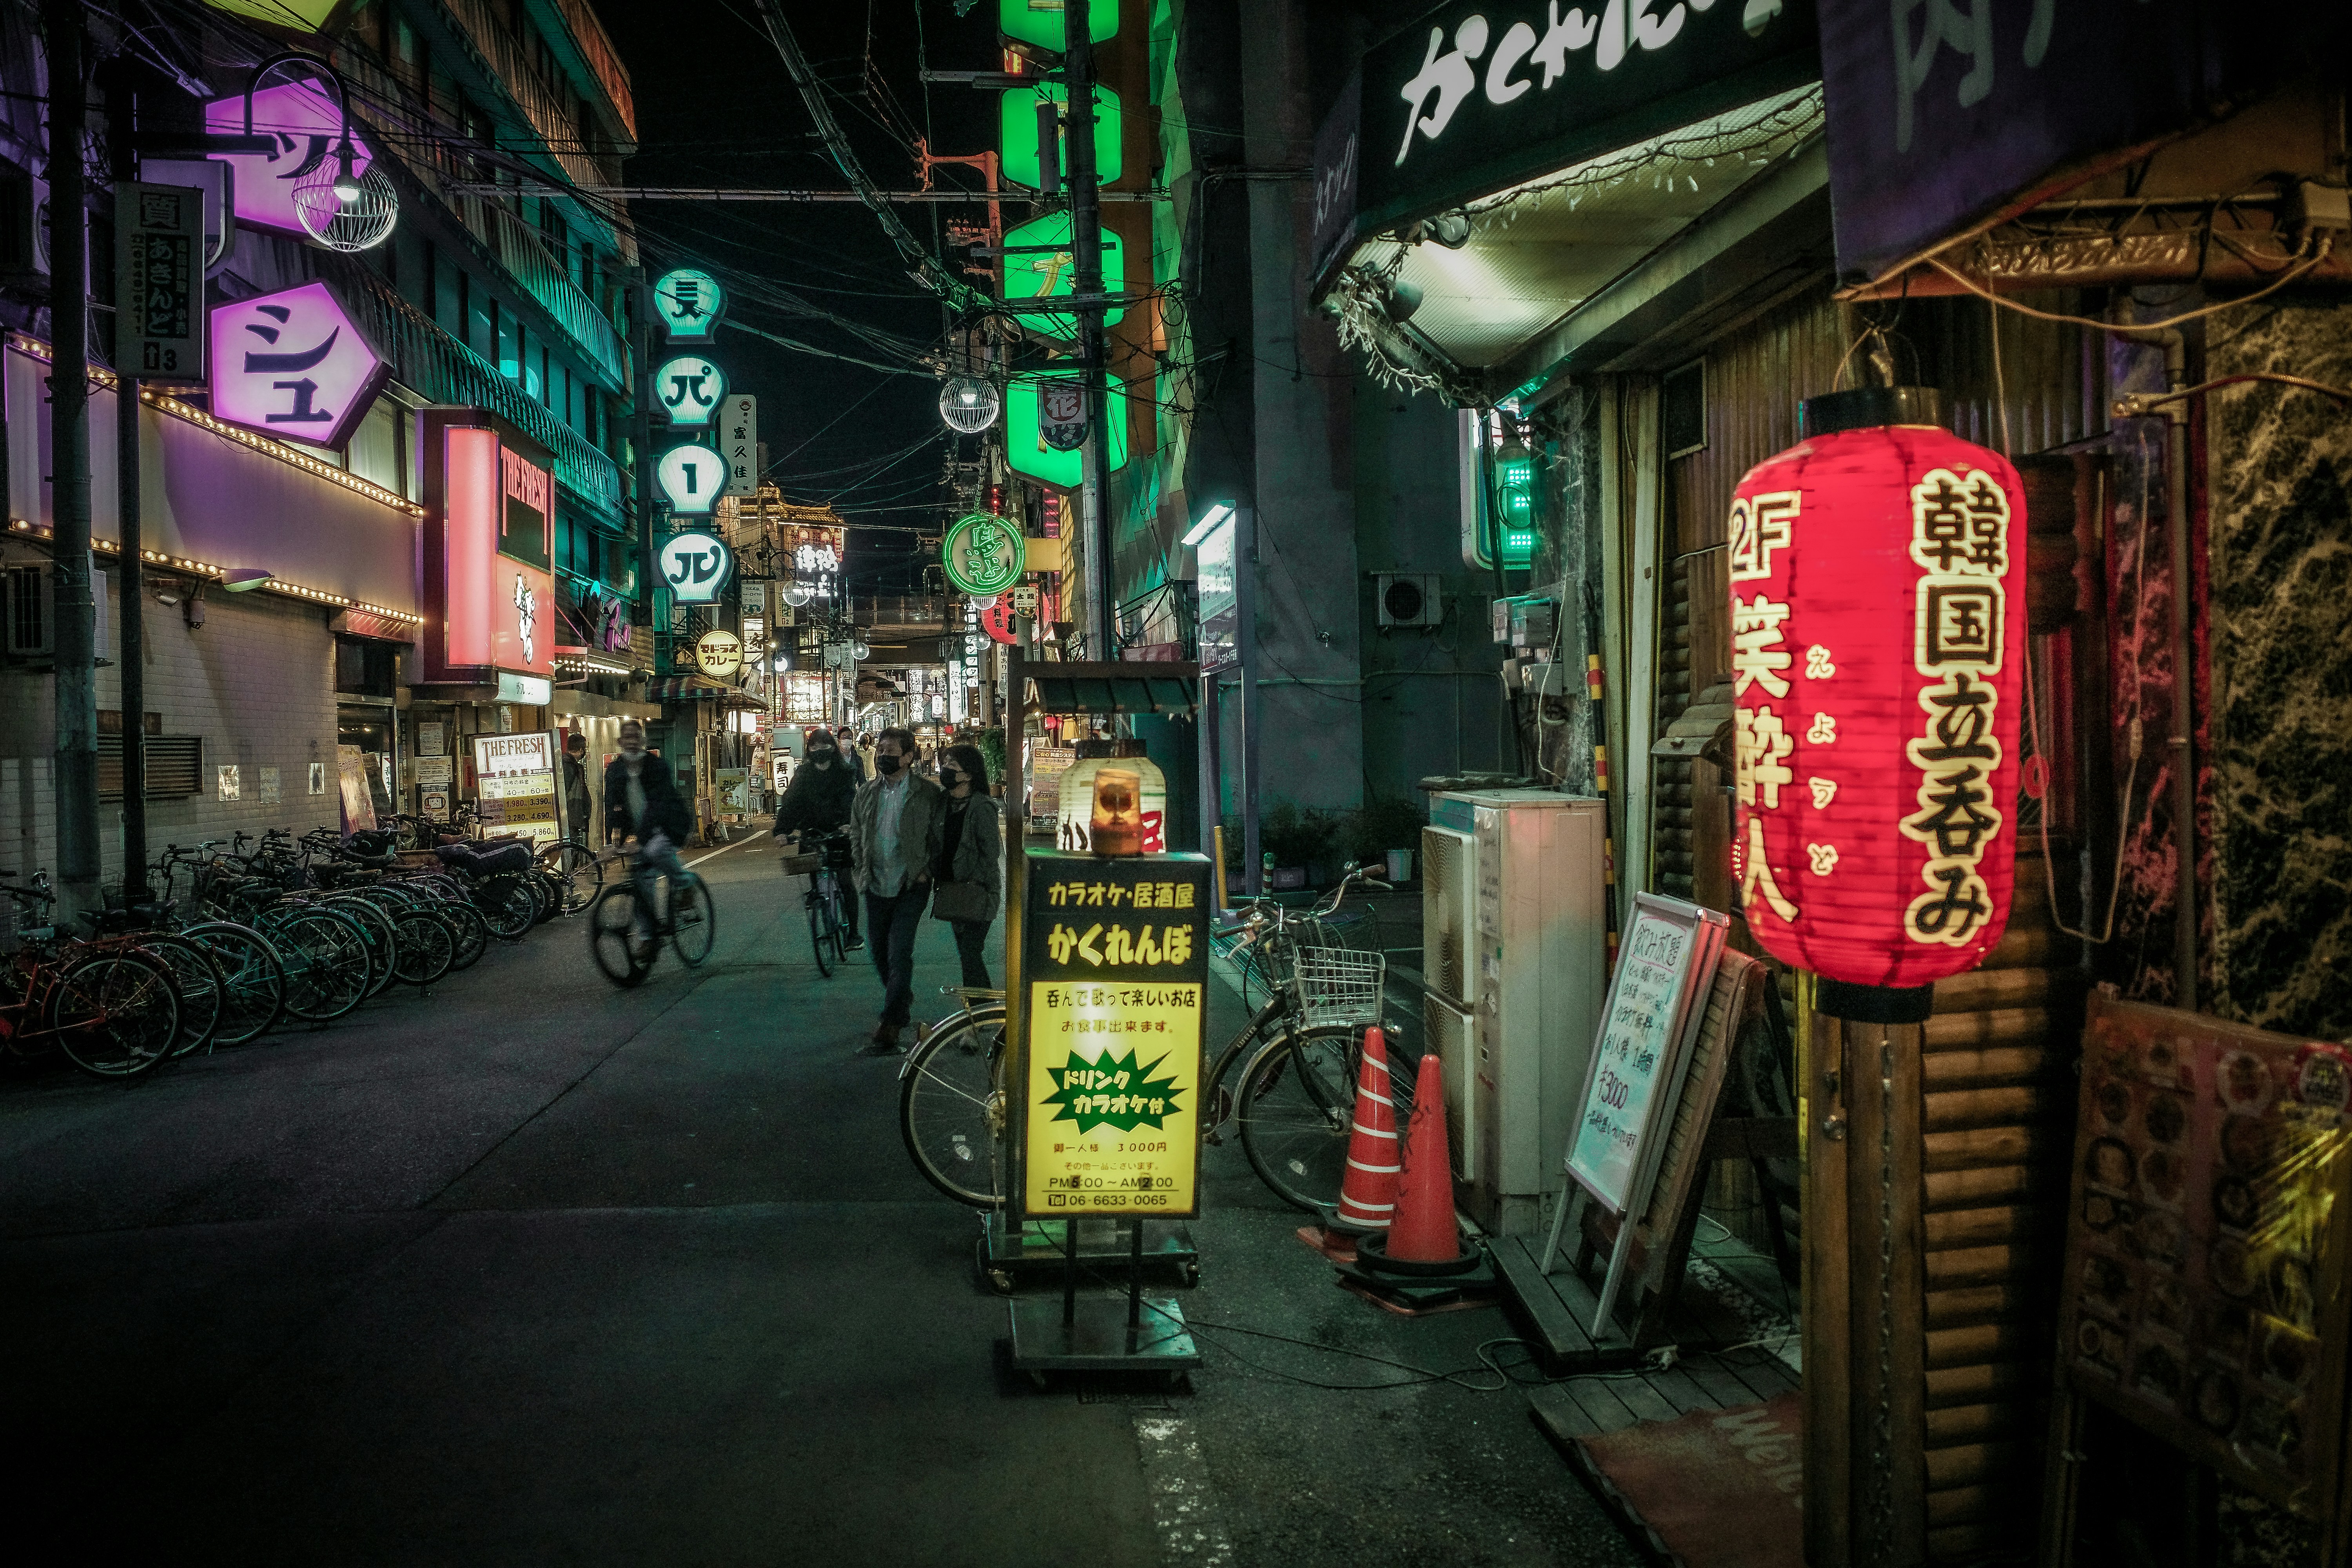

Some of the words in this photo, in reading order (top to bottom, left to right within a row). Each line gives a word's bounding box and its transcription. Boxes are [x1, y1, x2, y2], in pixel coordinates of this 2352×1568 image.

[1395, 0, 1783, 167] かくれん
[149, 237, 174, 335] あきんど
[163, 348, 177, 371] 3
[244, 305, 340, 423] シュ
[733, 426, 747, 478] 富久佳
[501, 445, 521, 537] THE
[520, 457, 548, 555] FRESH
[701, 644, 738, 653] マドラス
[705, 655, 739, 666] カレー
[1900, 469, 2010, 946] 韓国立呑み
[482, 741, 506, 771] THE
[507, 737, 547, 767] FRESH
[776, 762, 789, 788] 寿司
[1049, 882, 1194, 908] カラオケ・居酒屋
[1048, 923, 1192, 966] かくれんぼ
[1063, 1069, 1130, 1090] ドリンク
[1073, 1094, 1164, 1115] カラオケ付
